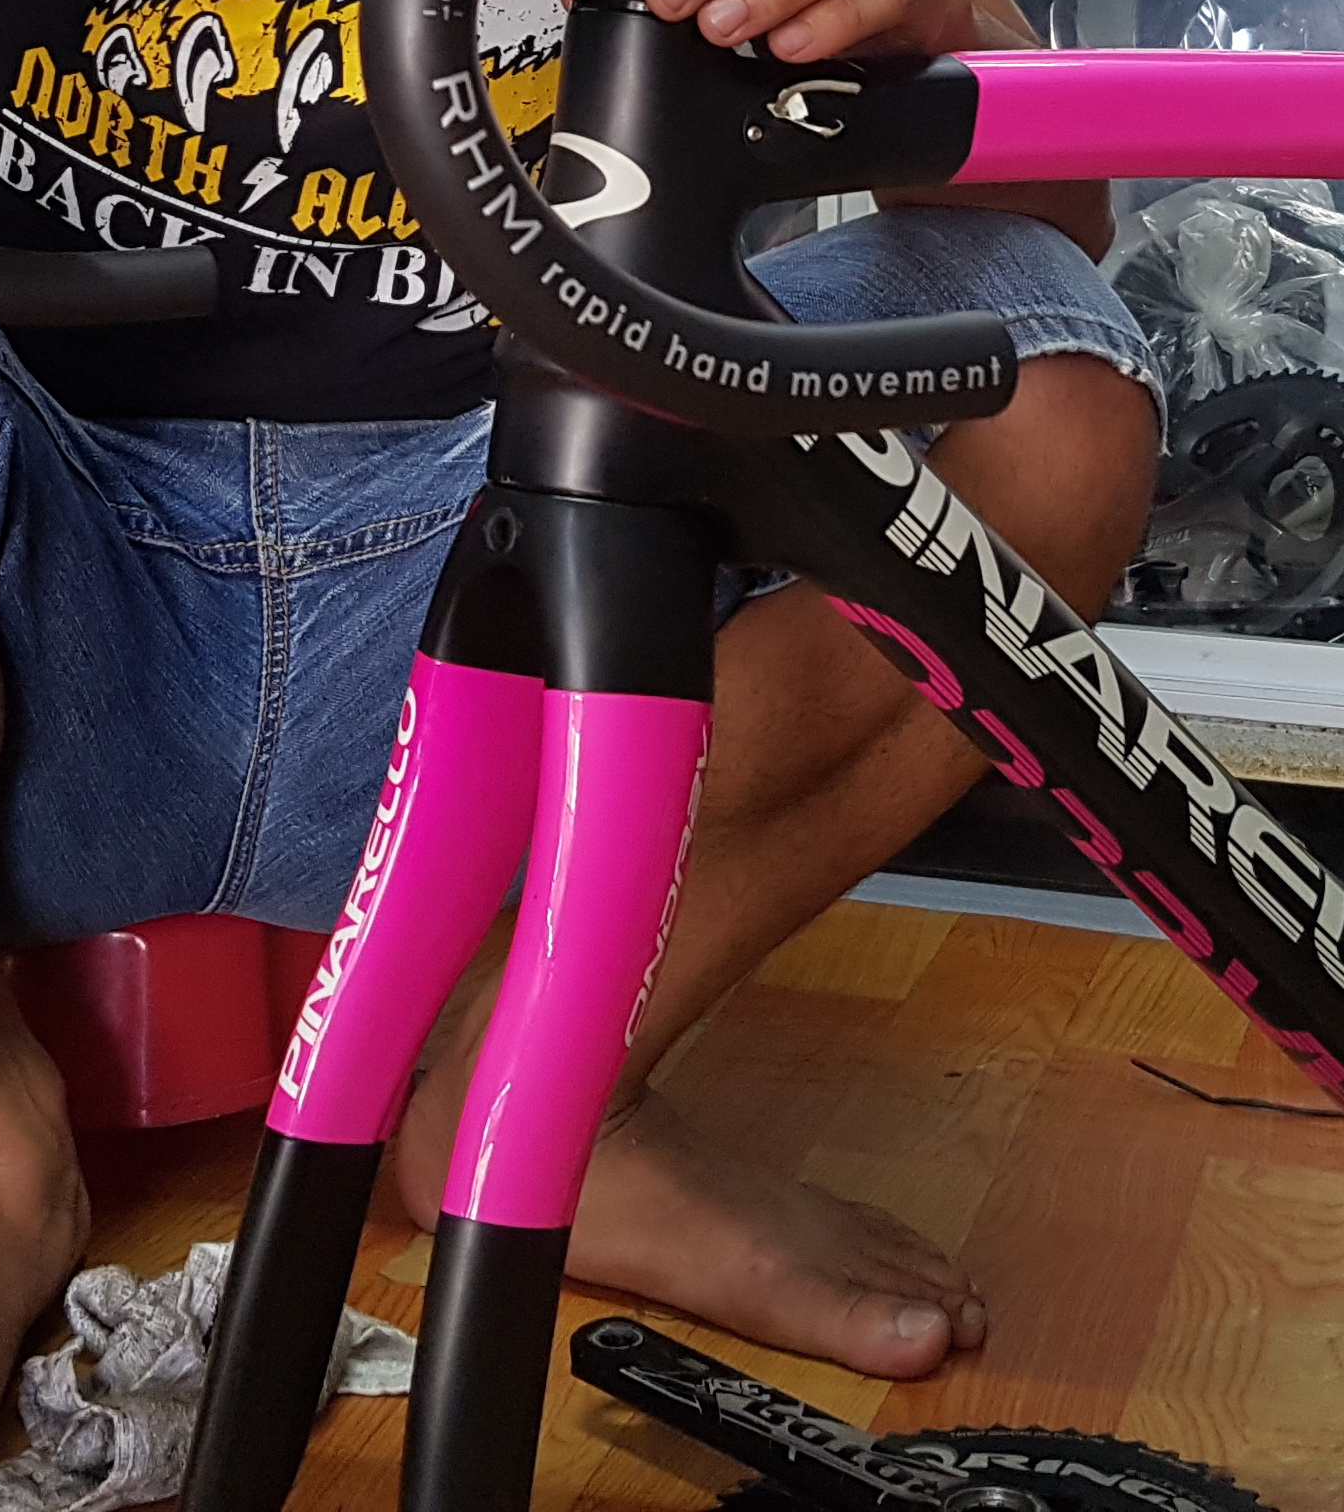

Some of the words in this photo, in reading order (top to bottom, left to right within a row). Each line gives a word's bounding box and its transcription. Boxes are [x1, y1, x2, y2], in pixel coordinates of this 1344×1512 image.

[443, 4, 451, 22] 1
[9, 44, 230, 206] NORTH
[242, 243, 355, 299] IN
[432, 69, 544, 255] RHM
[540, 261, 653, 354] rapid
[663, 333, 772, 395] hand
[790, 356, 1005, 399] movement
[278, 685, 419, 1100] PINARELLO
